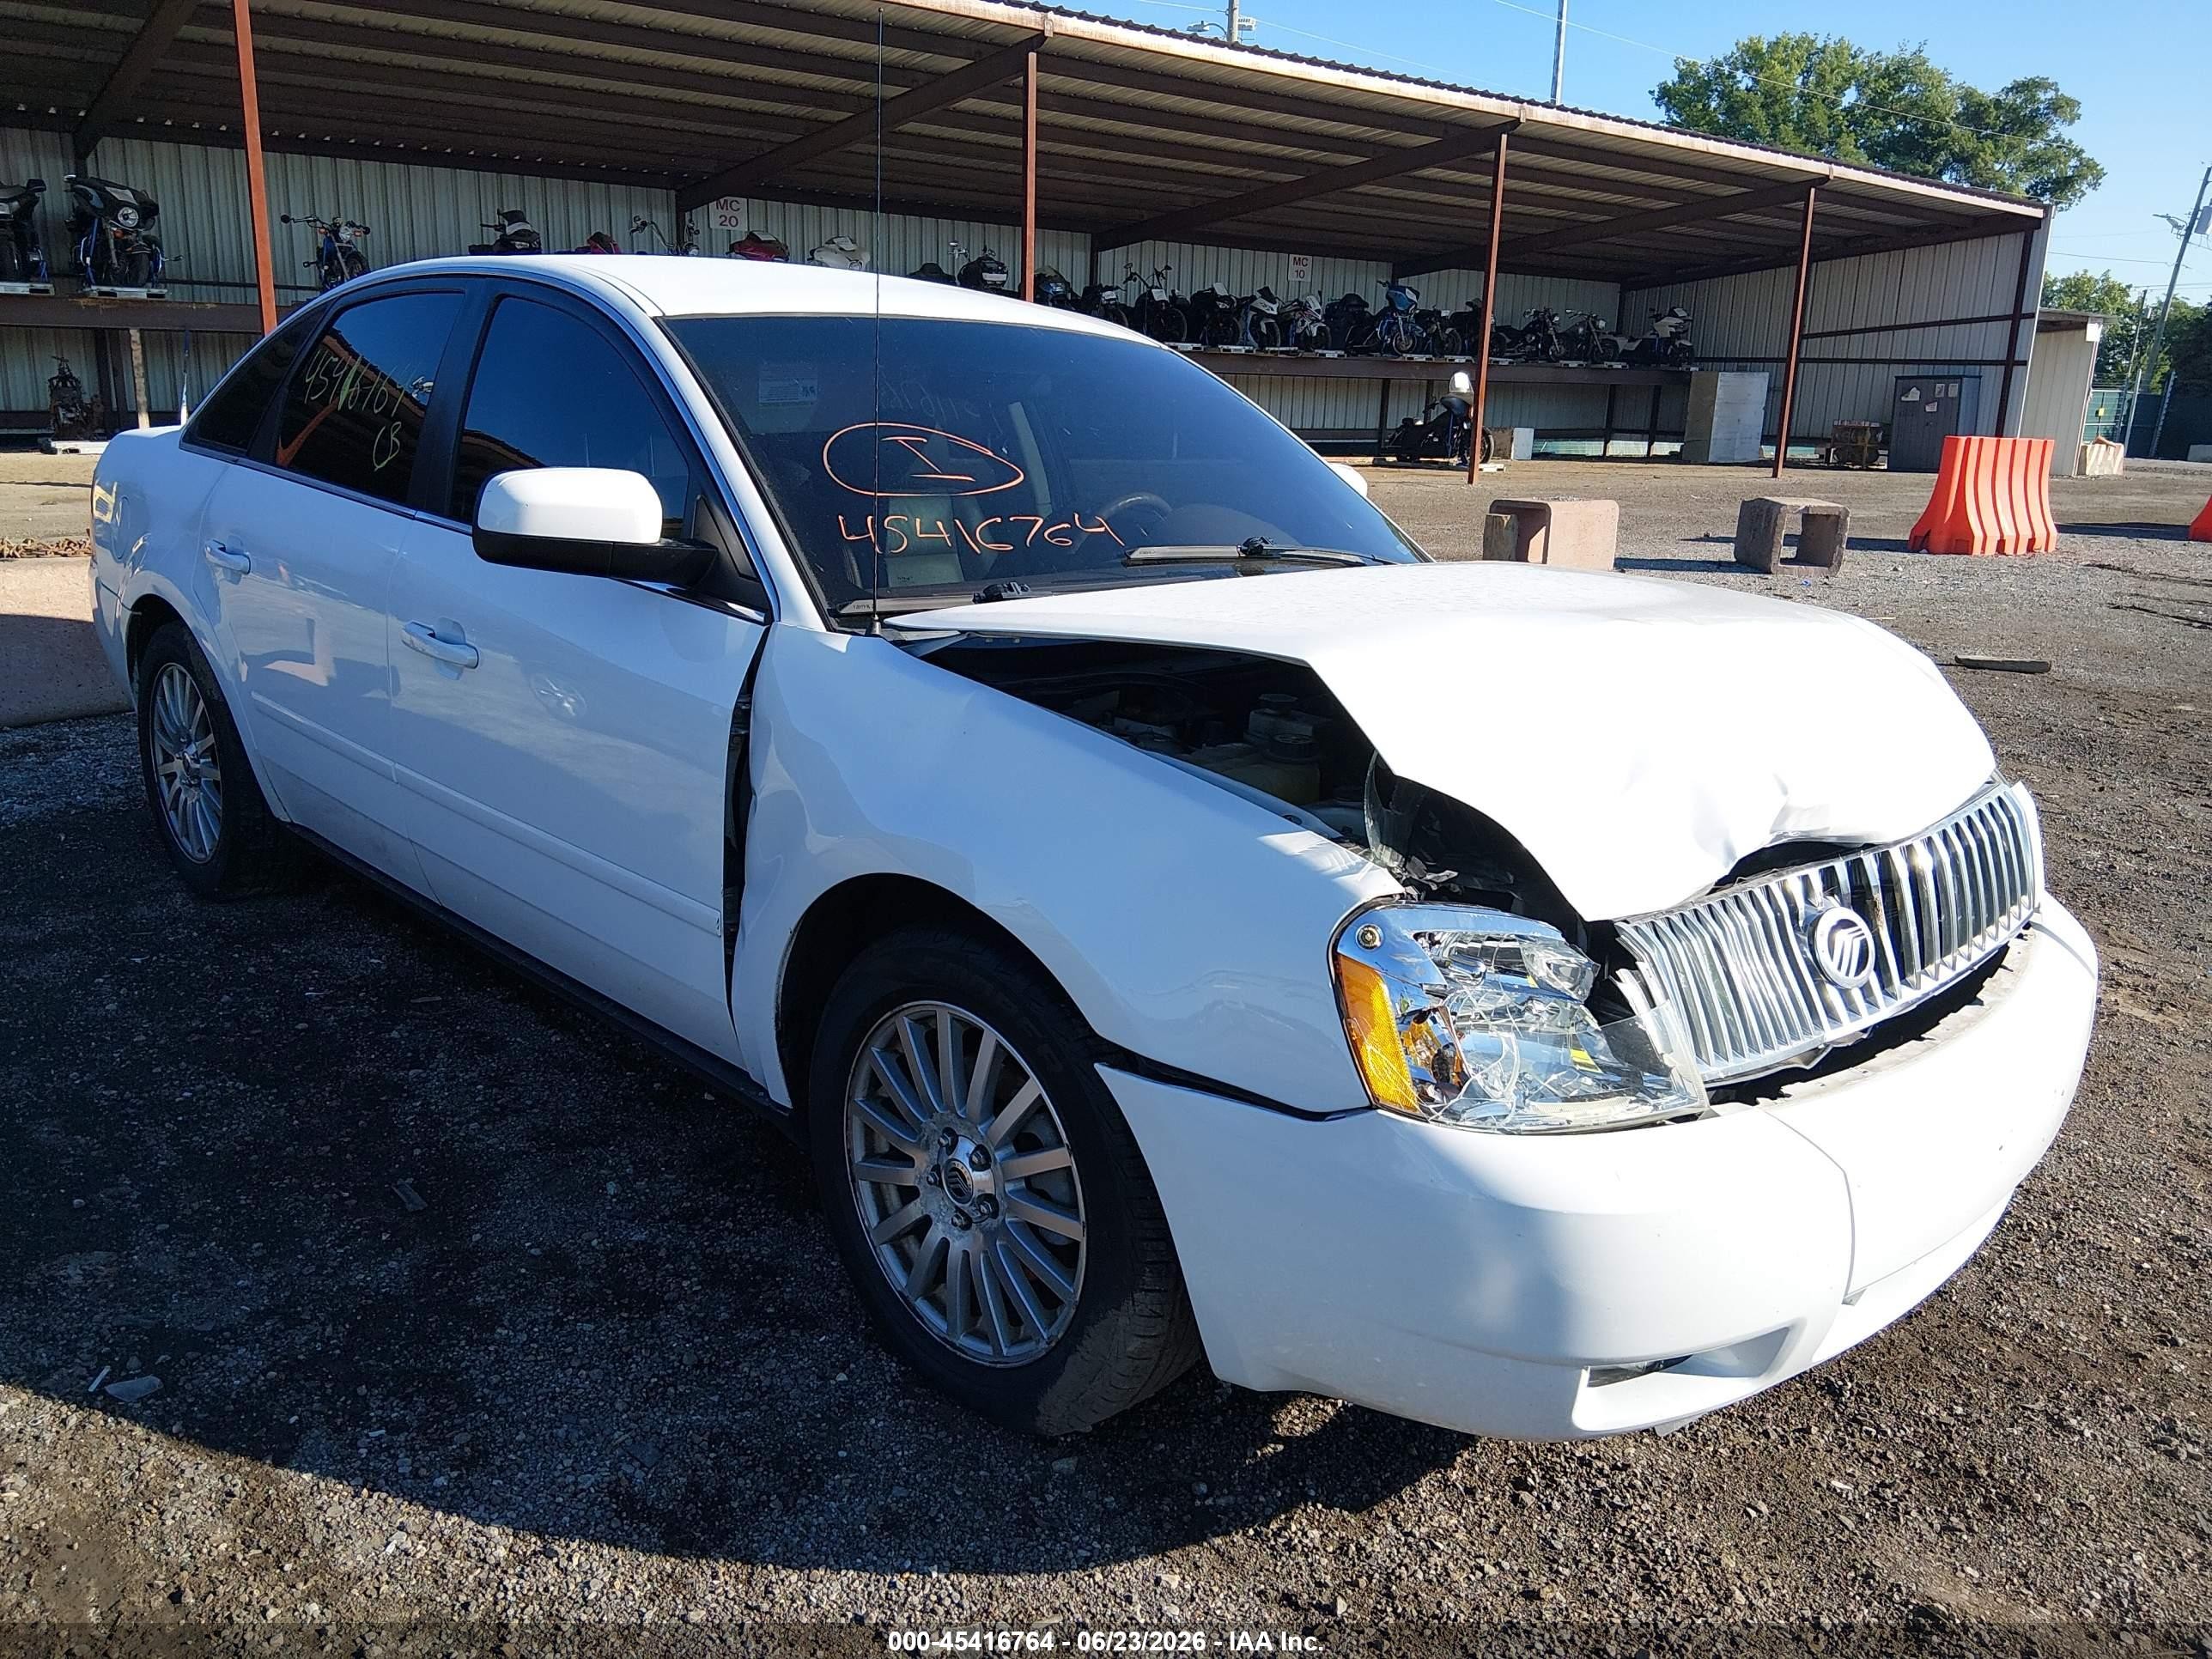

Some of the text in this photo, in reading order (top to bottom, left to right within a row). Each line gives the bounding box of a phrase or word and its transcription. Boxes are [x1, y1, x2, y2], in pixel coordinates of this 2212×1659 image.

[715, 198, 741, 212] MC
[719, 215, 739, 228] 20
[1292, 257, 1310, 267] MC
[1294, 269, 1306, 279] 10
[837, 511, 1126, 555] 45416764
